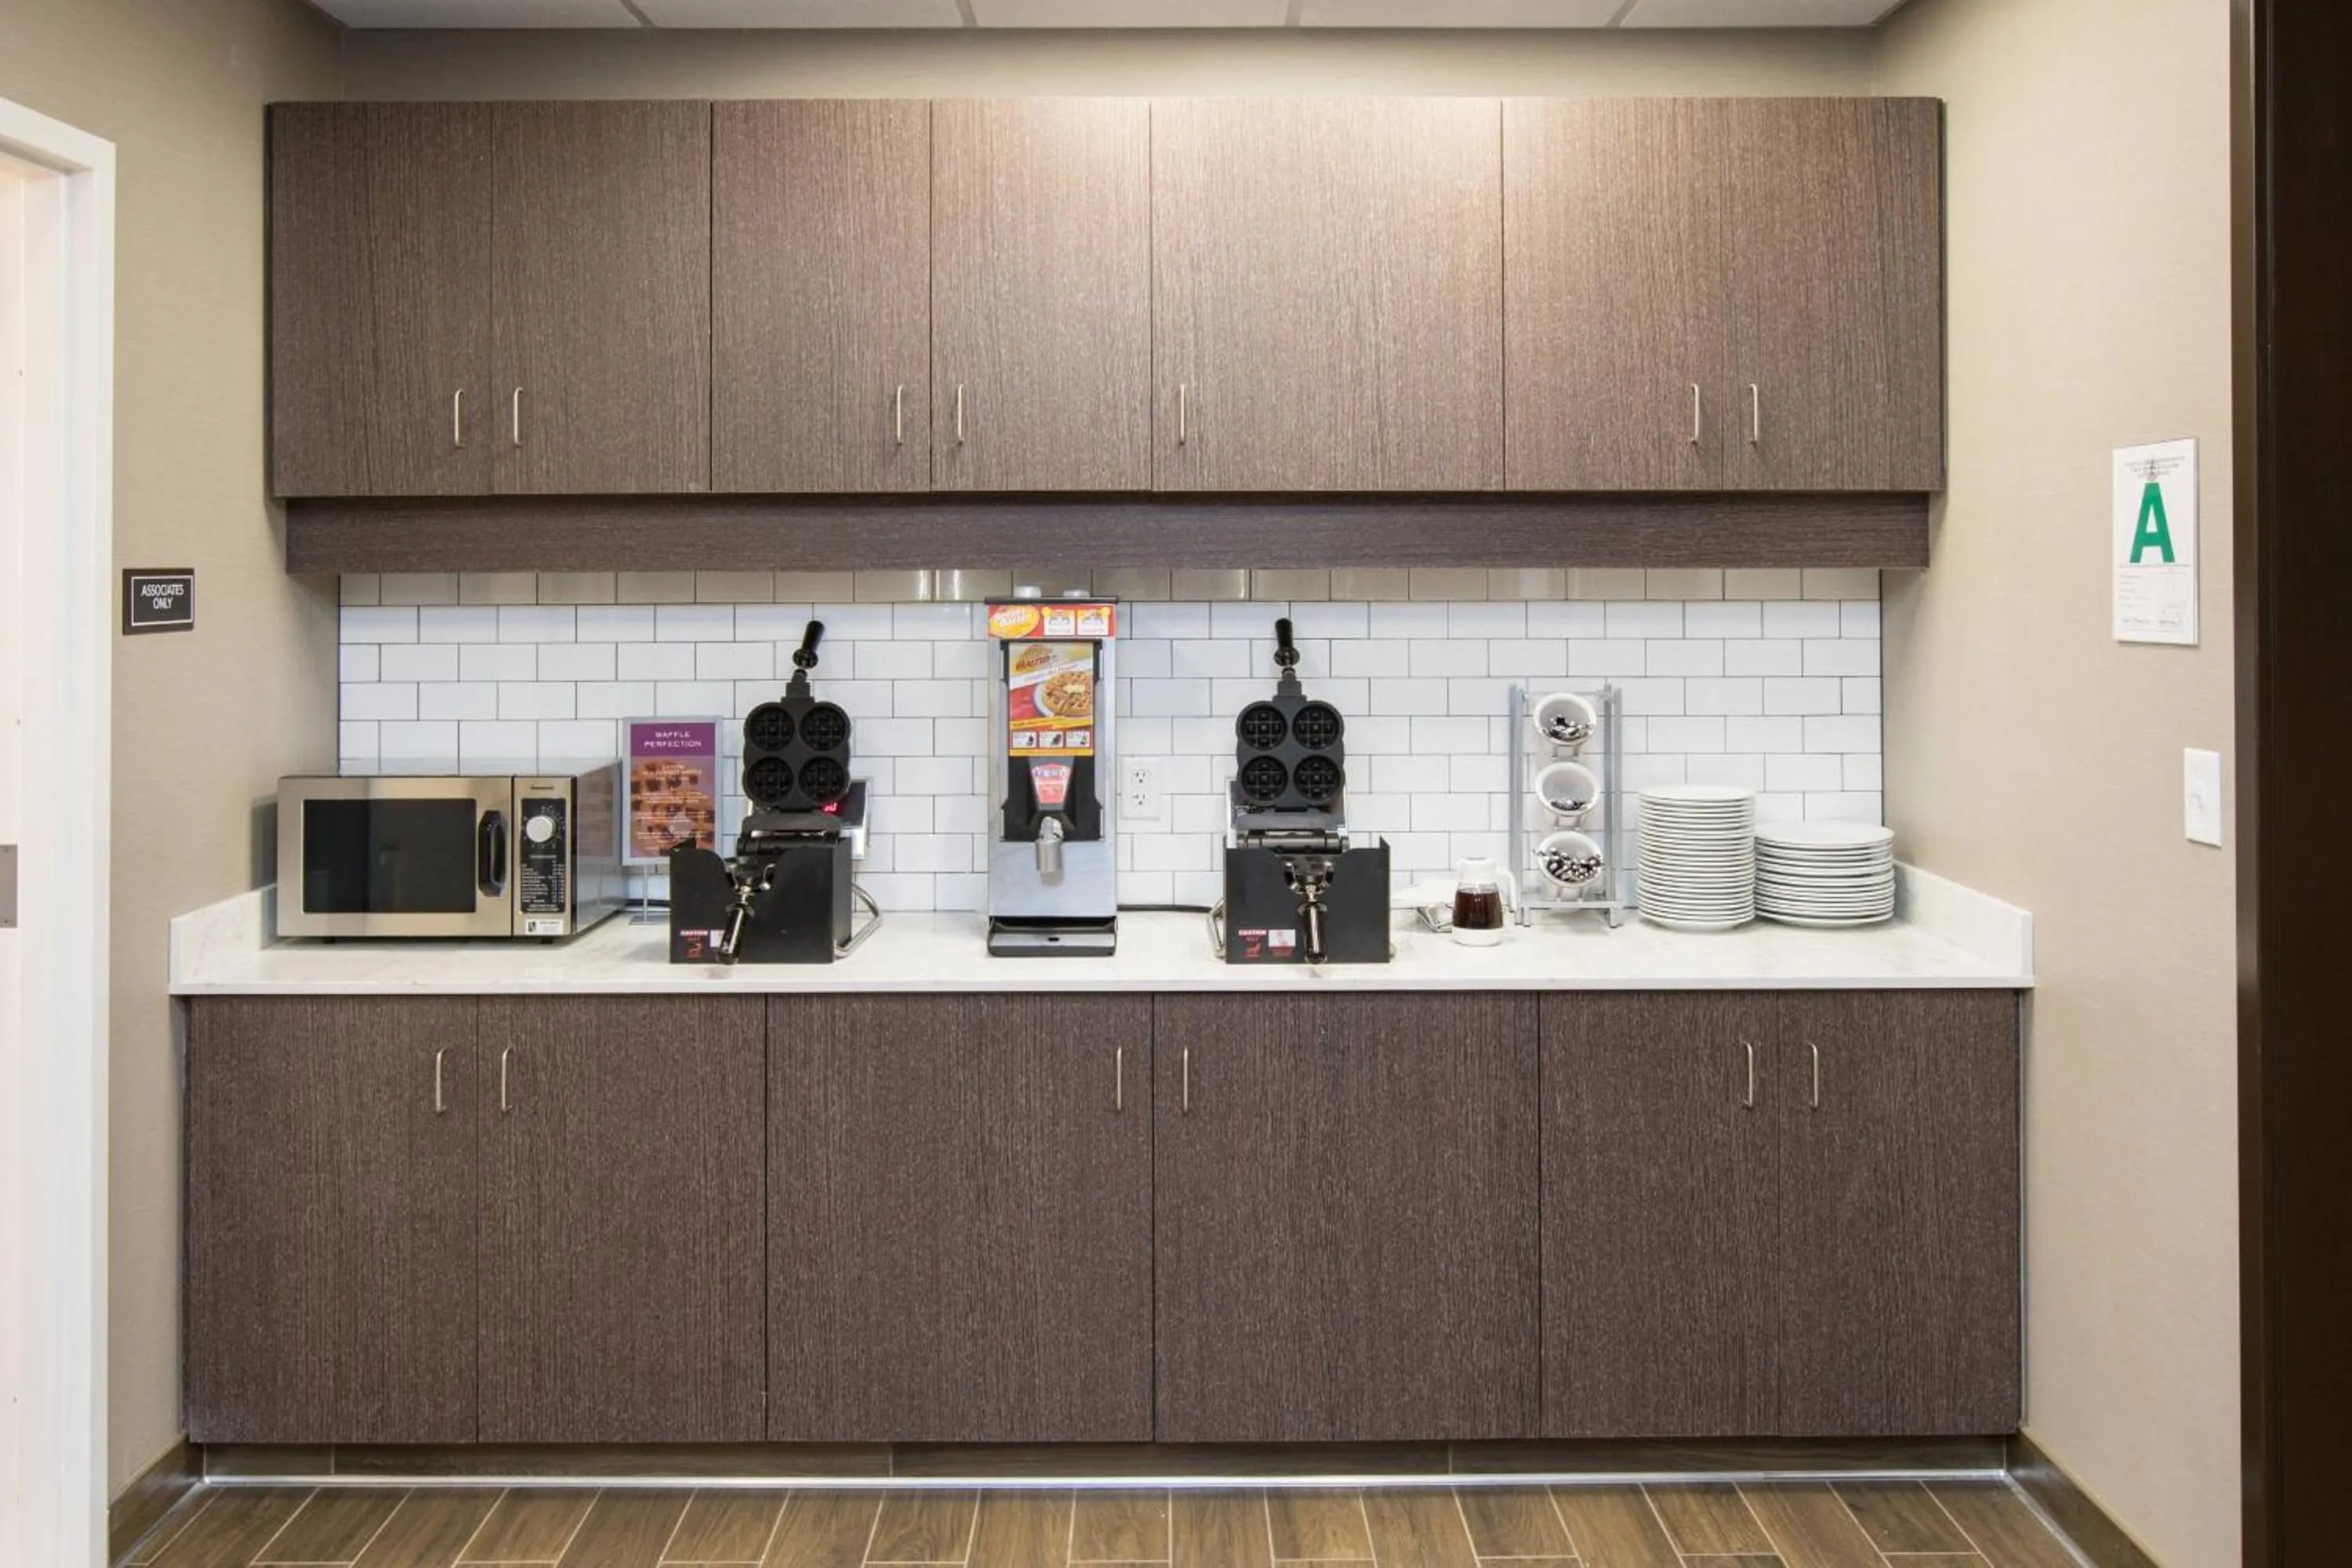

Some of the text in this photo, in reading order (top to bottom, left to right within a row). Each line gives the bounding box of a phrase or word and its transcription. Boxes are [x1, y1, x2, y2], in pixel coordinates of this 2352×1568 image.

[2129, 482, 2176, 563] A
[141, 584, 184, 597] ASSOCIATES
[152, 597, 173, 608] ONLY
